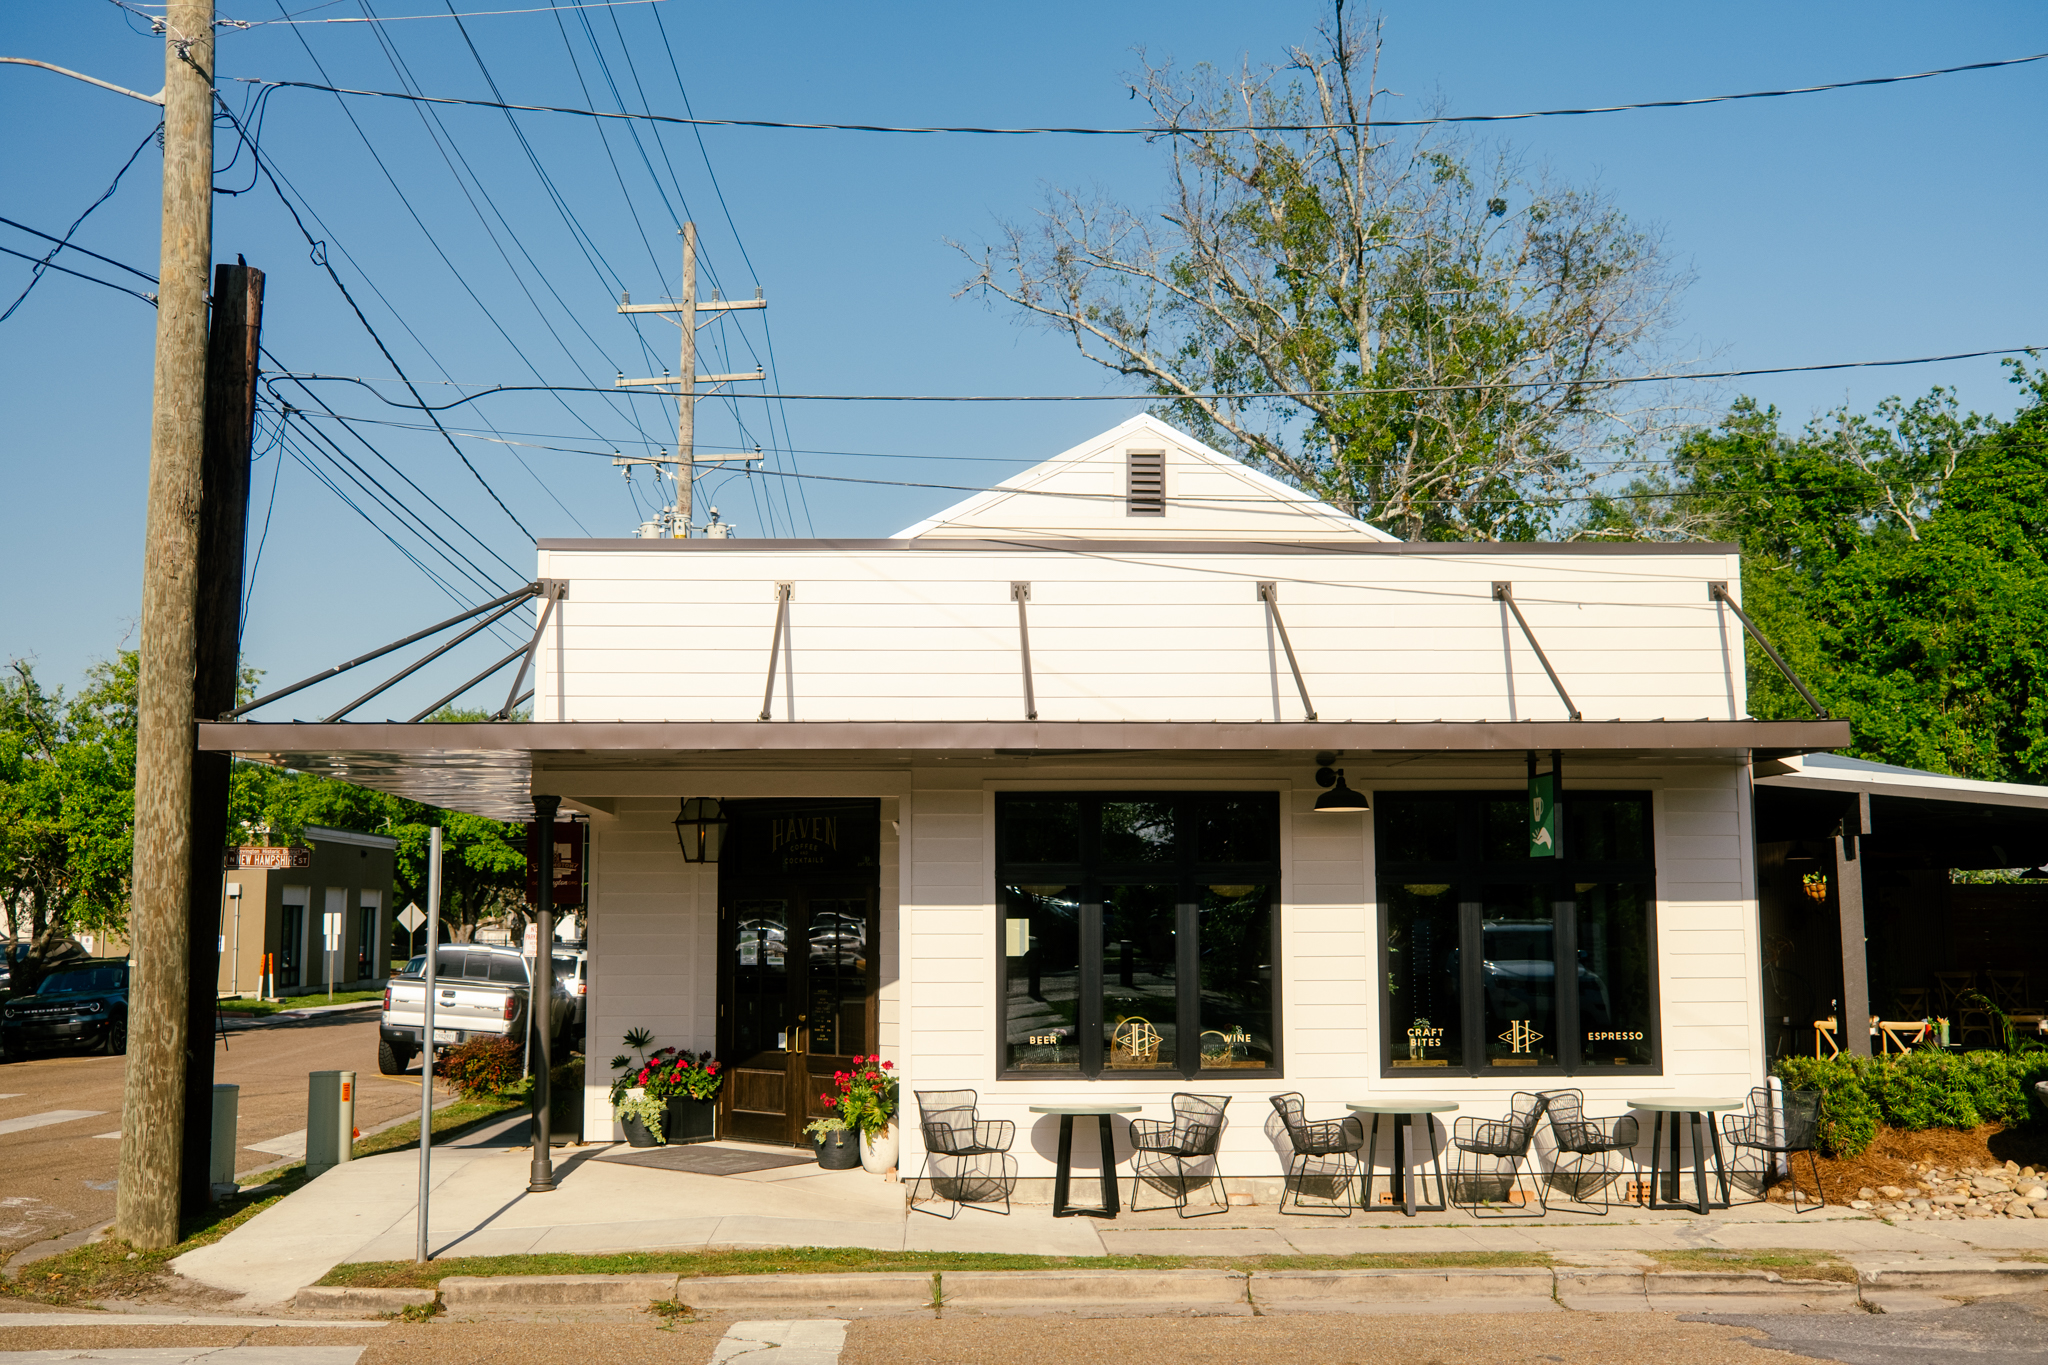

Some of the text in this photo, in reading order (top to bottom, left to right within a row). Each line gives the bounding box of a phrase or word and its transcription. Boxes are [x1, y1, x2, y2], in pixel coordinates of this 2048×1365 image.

[772, 816, 837, 853] HAVEN
[790, 843, 818, 852] COFFEE
[236, 855, 252, 866] NEW
[254, 855, 298, 866] HAMPSHIRE
[1407, 1028, 1444, 1037] CRAFT
[1587, 1031, 1644, 1041] ESPRESSO
[1029, 1035, 1057, 1045] BEER
[1223, 1033, 1252, 1043] WINE
[1410, 1037, 1441, 1047] BITES
